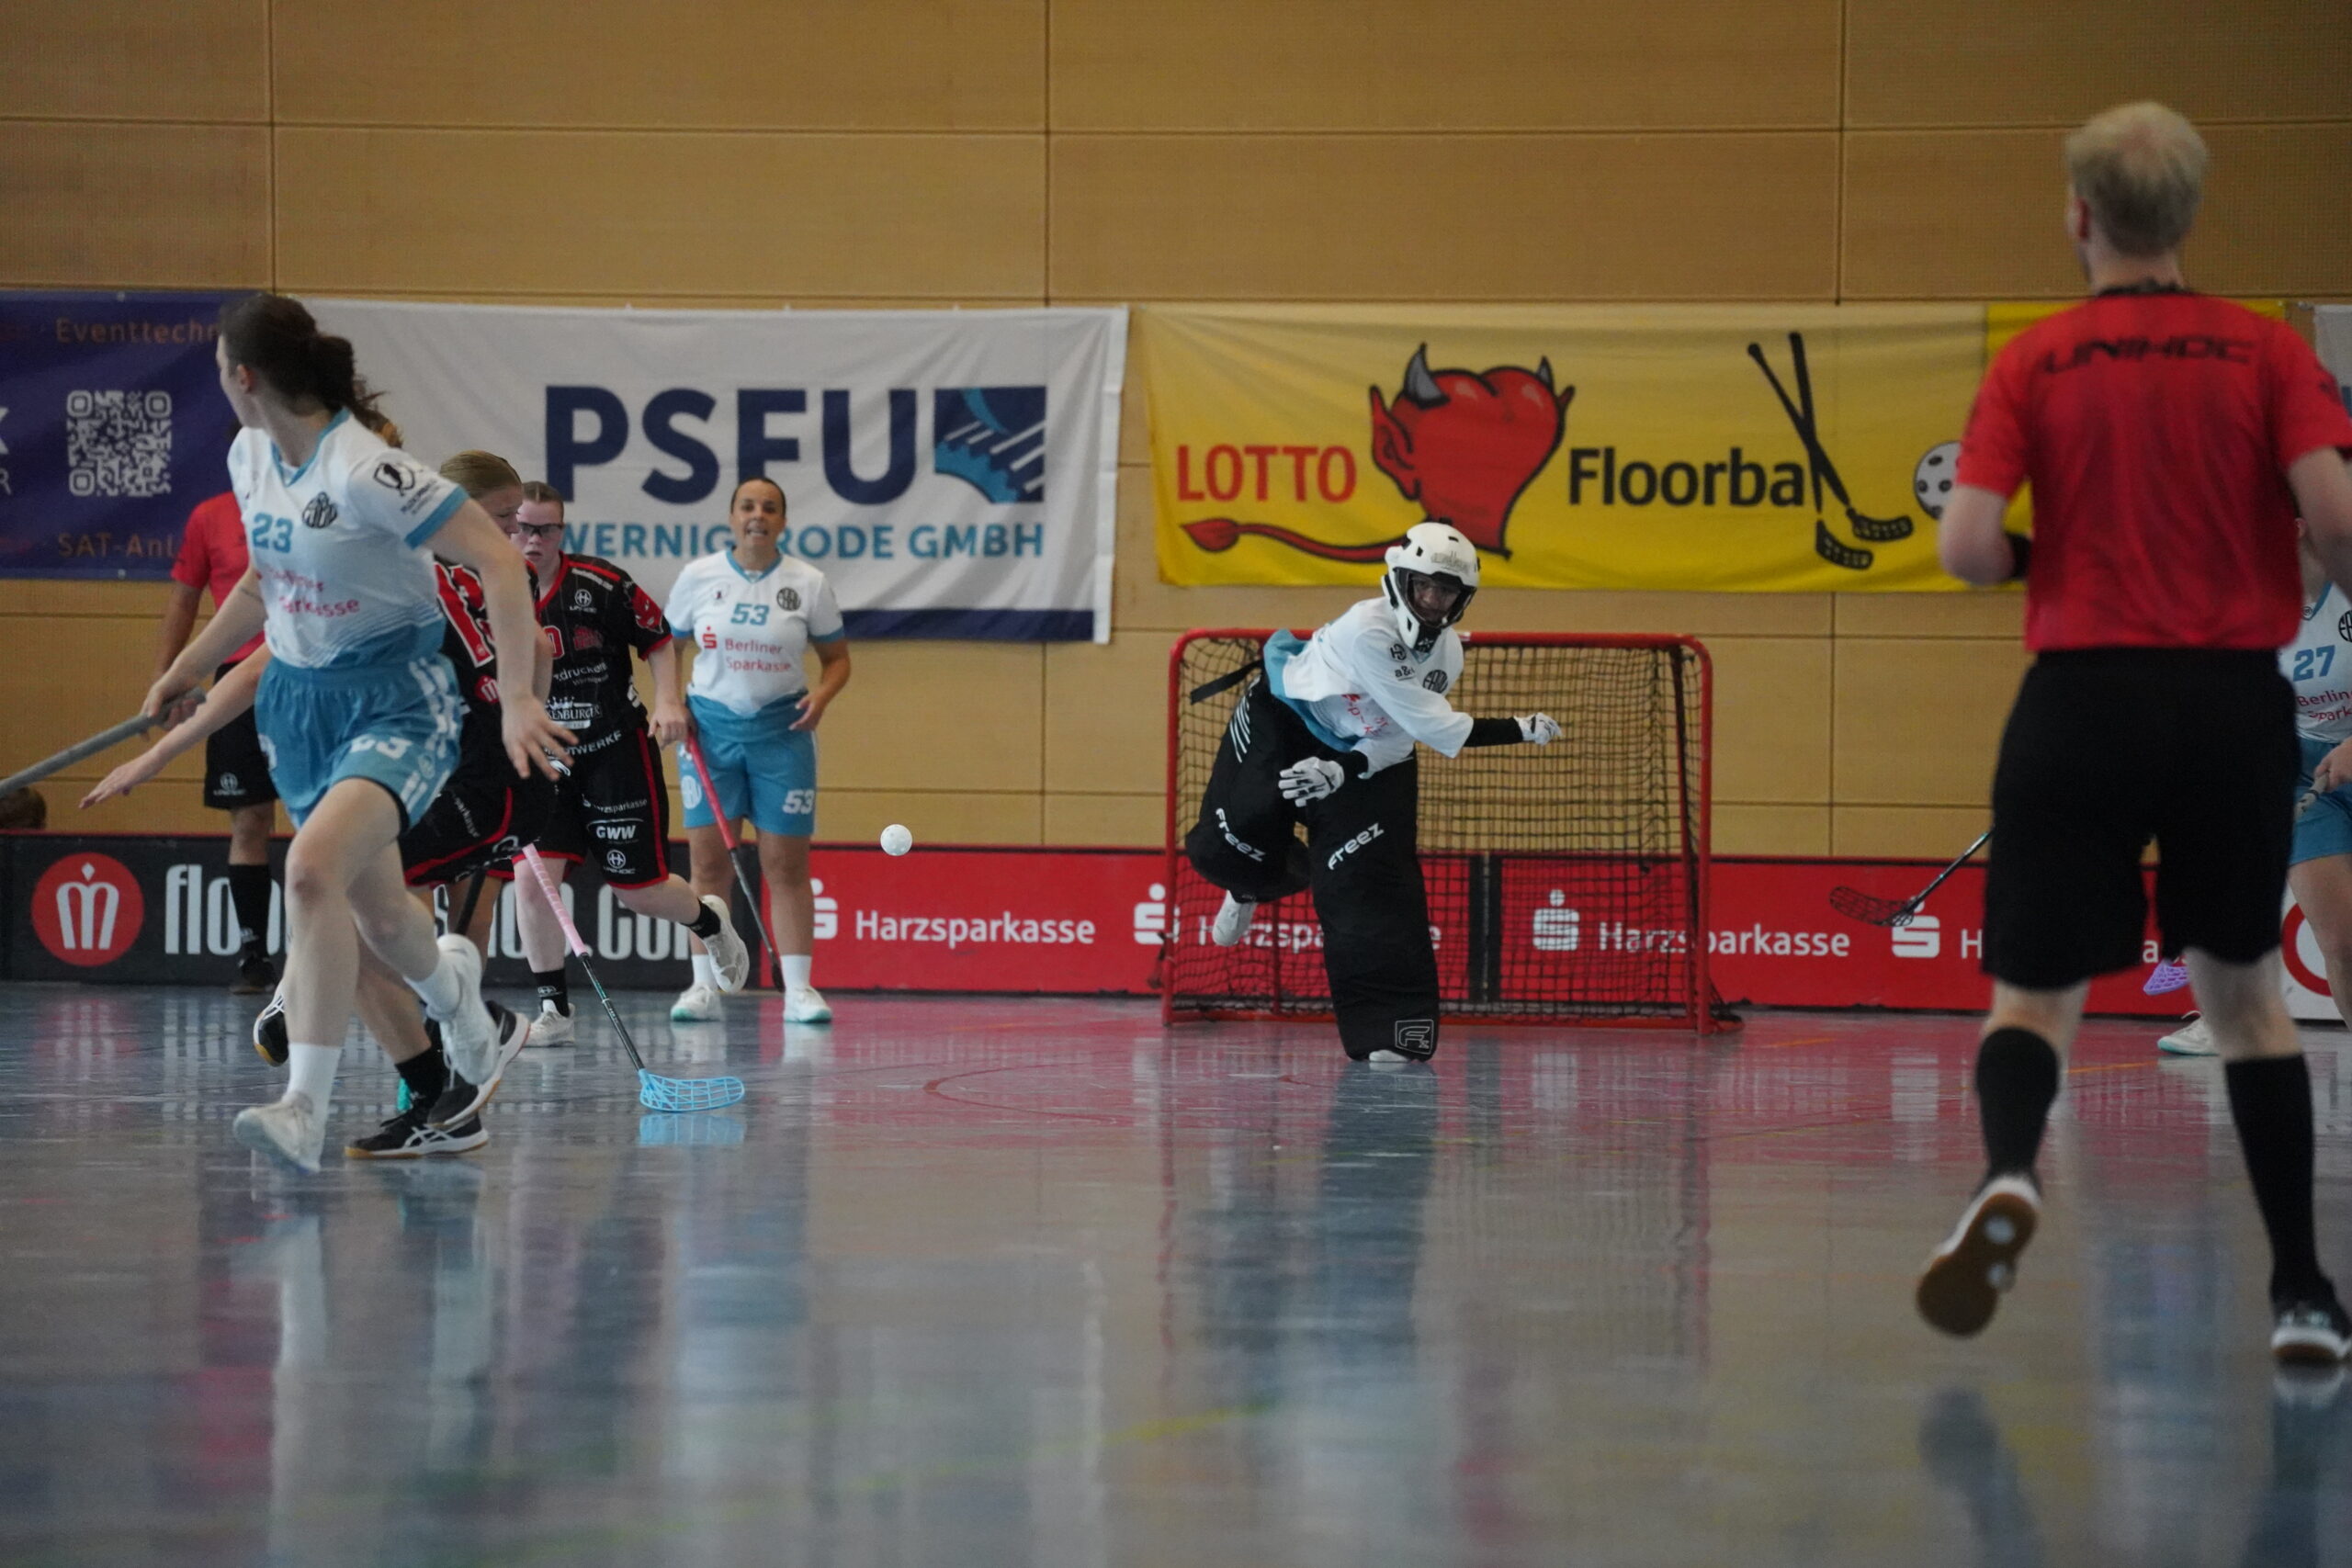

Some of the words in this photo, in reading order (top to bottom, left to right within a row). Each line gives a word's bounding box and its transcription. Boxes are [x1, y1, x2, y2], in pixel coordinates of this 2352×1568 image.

[546, 386, 917, 504] PSFU
[1177, 444, 1358, 502] LOTTO
[252, 512, 294, 554] 23
[562, 523, 895, 559] WERNIGRODE
[909, 523, 1044, 559] GMBH
[731, 603, 770, 626] 53
[724, 637, 783, 655] Berliner
[2293, 645, 2335, 682] 27
[783, 789, 815, 815] 53
[596, 825, 636, 840] GWW
[856, 910, 1096, 949] Harzsparkasse
